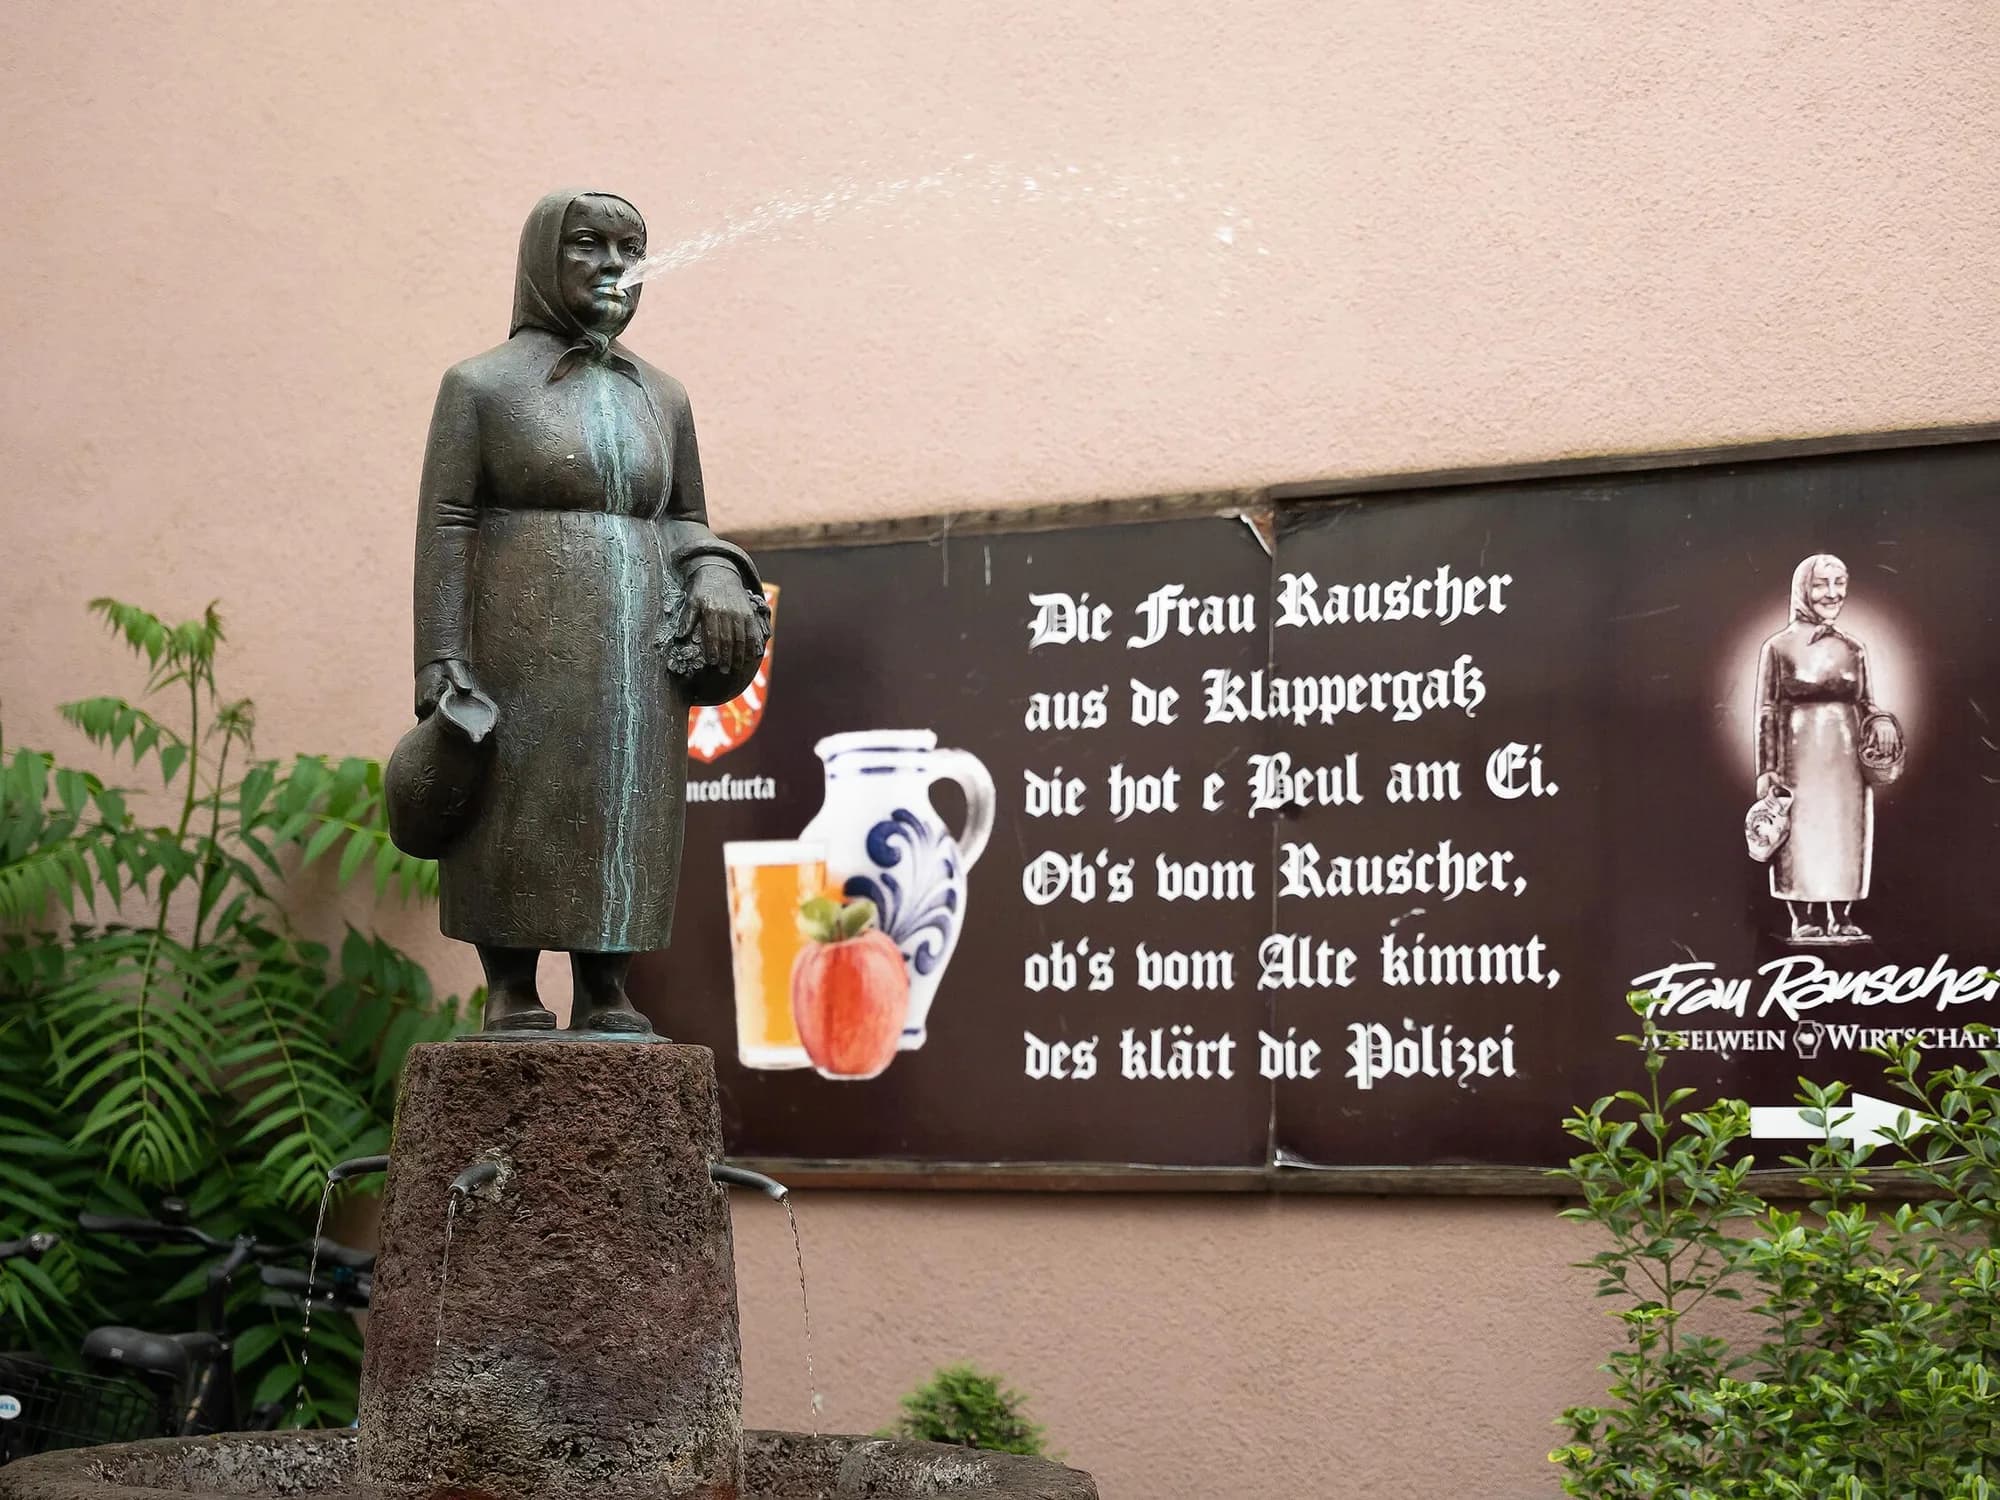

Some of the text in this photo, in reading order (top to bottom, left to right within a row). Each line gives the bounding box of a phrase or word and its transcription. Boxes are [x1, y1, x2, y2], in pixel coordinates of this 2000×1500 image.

[1028, 565, 1512, 649] Die Frau Rauscher
[1025, 685, 1109, 732] aus
[1130, 678, 1180, 727] de
[1024, 742, 1559, 822] die hot e Beul am Ei.
[1156, 854, 1256, 902] vom
[1279, 840, 1528, 902] Rauscher,
[1136, 943, 1235, 991] vom
[1258, 934, 1358, 991] Alte
[1380, 933, 1561, 989] kimmt,
[1631, 954, 2000, 1021] Frau Rauscher
[1024, 1022, 1516, 1090] des klärt die Polizei
